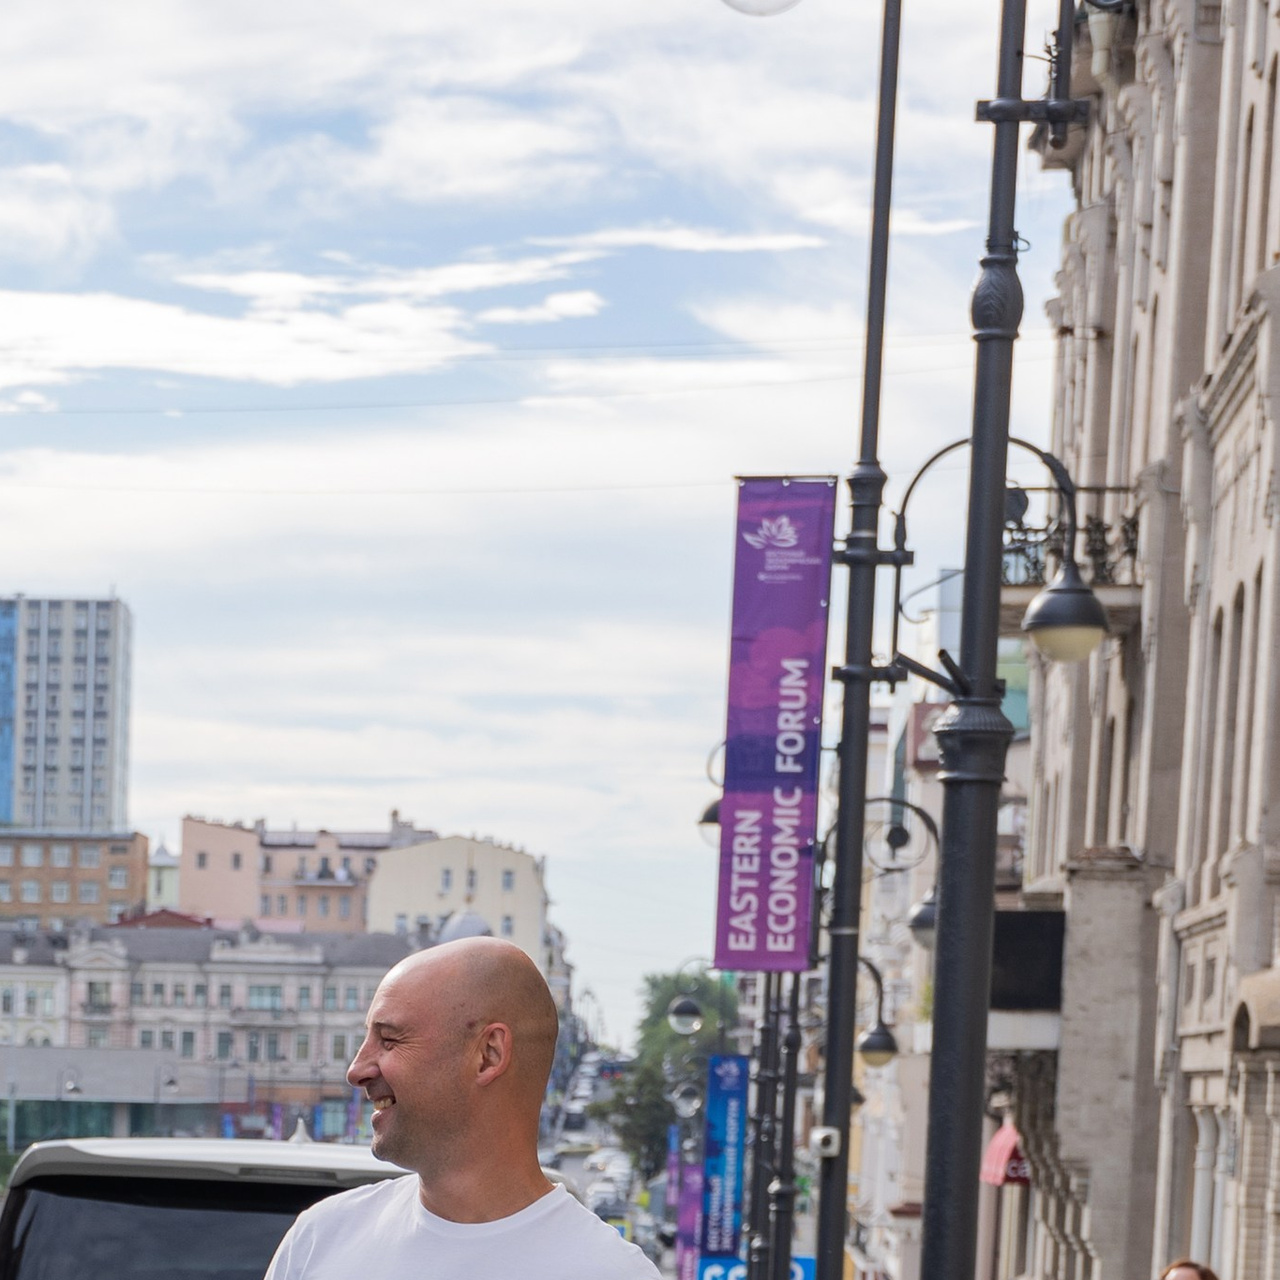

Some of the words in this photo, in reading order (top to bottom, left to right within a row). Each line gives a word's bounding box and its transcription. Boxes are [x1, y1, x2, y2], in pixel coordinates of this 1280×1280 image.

[775, 658, 810, 774] FORUM
[729, 809, 762, 953] EASTERN
[766, 786, 803, 953] ECONOMIC
